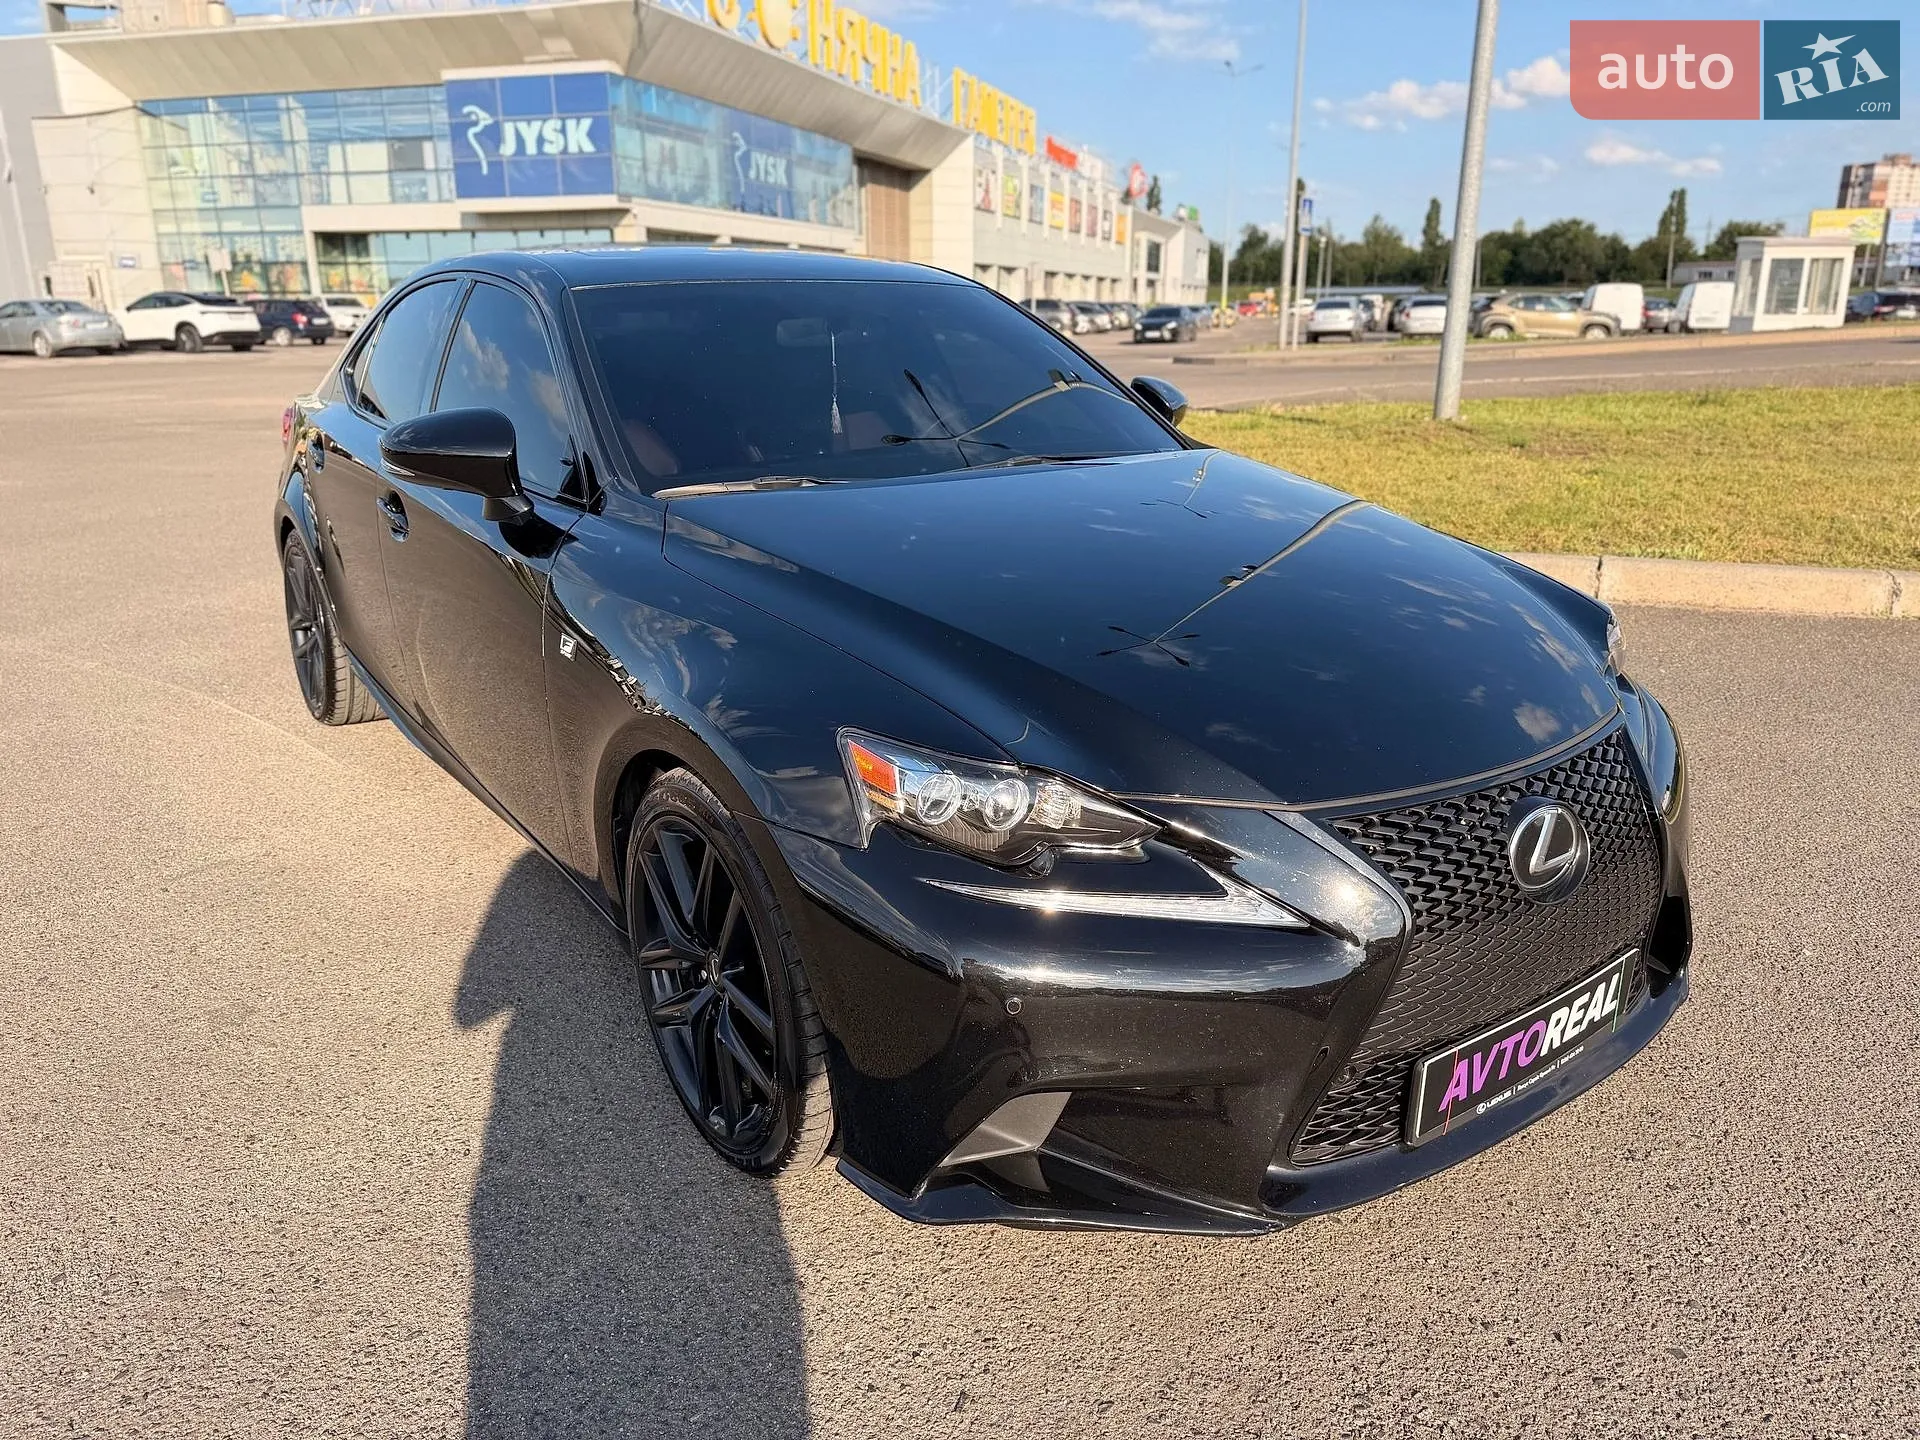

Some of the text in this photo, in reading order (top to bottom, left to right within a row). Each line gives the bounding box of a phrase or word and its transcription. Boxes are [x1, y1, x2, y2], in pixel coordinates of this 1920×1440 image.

[499, 117, 596, 156] JYSK
[749, 151, 788, 186] JYSK
[1438, 972, 1620, 1112] AVTOREAL
